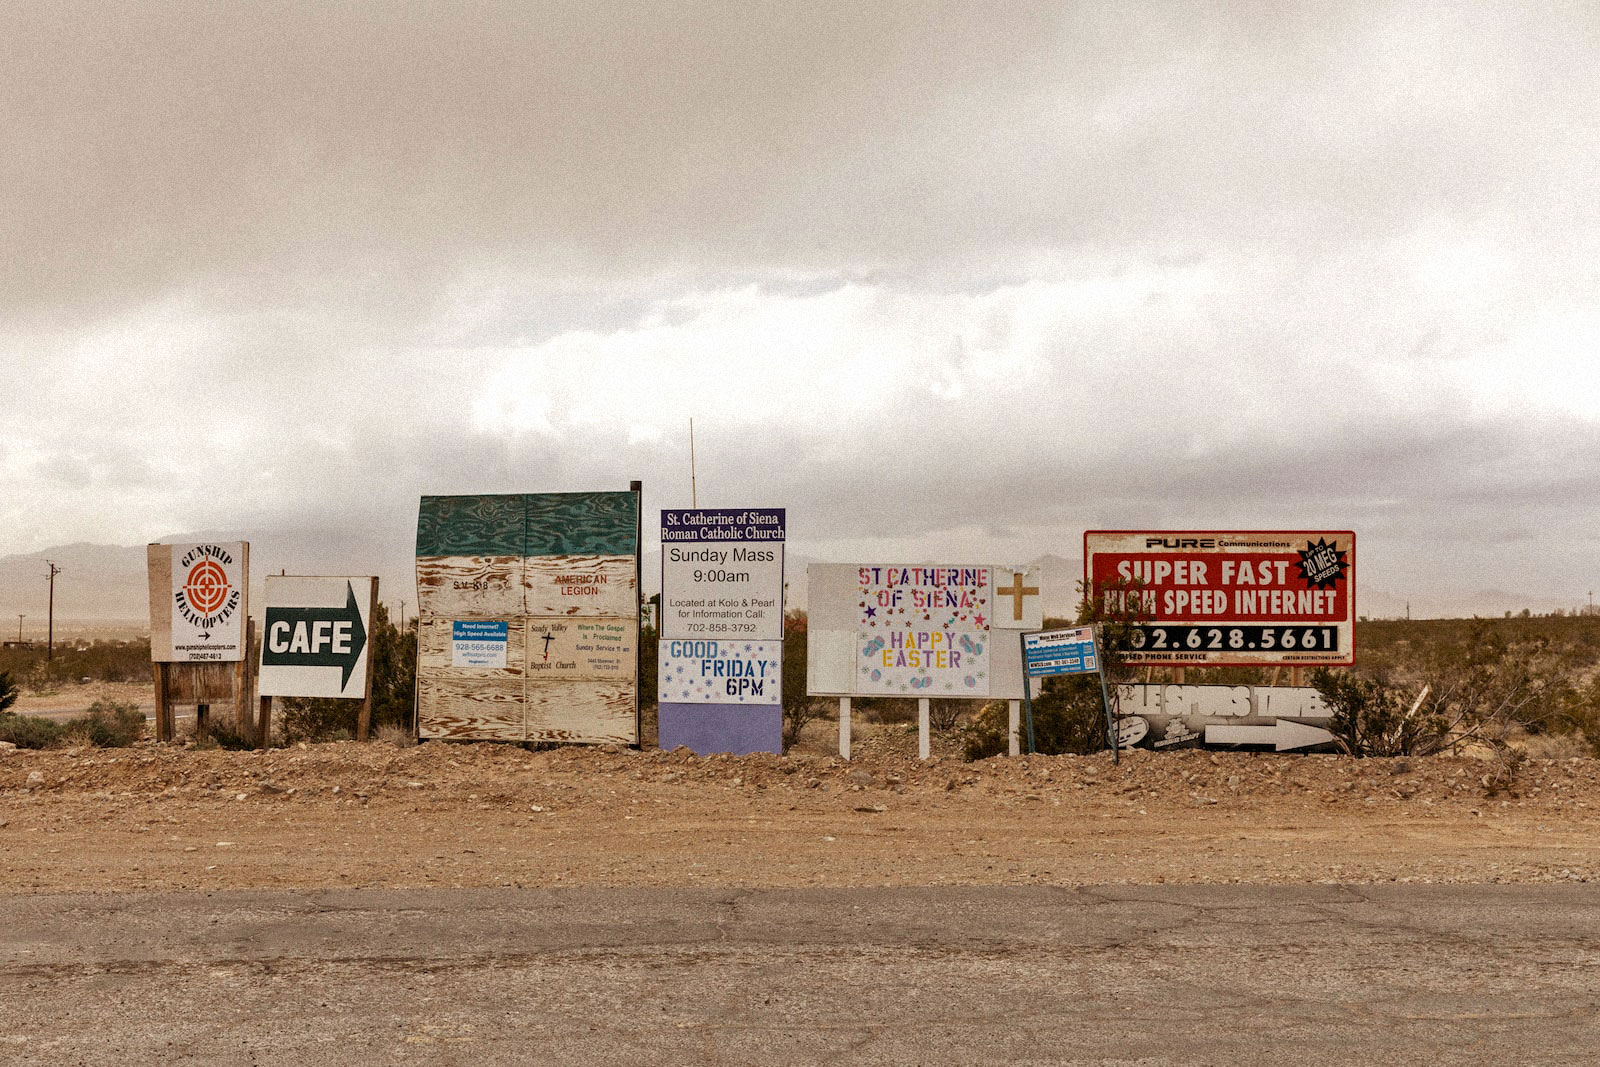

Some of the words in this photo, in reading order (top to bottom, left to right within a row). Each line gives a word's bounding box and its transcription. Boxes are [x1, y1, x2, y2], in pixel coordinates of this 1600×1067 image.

[667, 512, 681, 526] St.
[682, 512, 734, 525] Catherine
[736, 512, 748, 525] of
[749, 511, 779, 525] Siena
[661, 527, 698, 540] Roman
[699, 526, 744, 540] Catholic
[745, 526, 785, 539] Church
[1146, 538, 1216, 549] PURE
[1218, 540, 1291, 548] Communications
[1314, 544, 1325, 553] TO
[182, 544, 233, 568] GUNSHIP
[670, 547, 728, 566] Sunday
[733, 548, 774, 562] Mass
[1303, 558, 1317, 578] 20
[1313, 547, 1338, 572] MEG
[555, 575, 607, 585] AMERICAN
[693, 569, 750, 583] 9:00am
[859, 568, 881, 586] ST
[887, 568, 988, 586] CATHERINE
[1117, 560, 1208, 586] SUPER
[1221, 560, 1290, 586] FAST
[1313, 563, 1341, 583] SPEEDS
[561, 587, 598, 596] LEGION
[877, 589, 903, 608] OF
[912, 589, 971, 608] SIENA
[175, 590, 241, 630] HELICOPTERS
[669, 599, 705, 607] Located
[741, 599, 748, 607] &
[751, 599, 775, 608] Pearl
[1104, 589, 1157, 614] HIGH
[1164, 589, 1228, 615] SPEED
[1234, 589, 1337, 615] INTERNET
[678, 610, 690, 618] for
[692, 610, 742, 618] Information
[745, 609, 766, 619] Call:
[531, 624, 548, 633] Sandy
[551, 624, 568, 633] Valley
[606, 624, 625, 632] Gospel
[686, 623, 757, 632] 702-858-3792
[268, 621, 353, 654] CAFE
[891, 631, 955, 650] HAPPY
[1110, 628, 1331, 649] 02.628.5661
[175, 643, 237, 652] www.gunshiphelicopters.com
[576, 644, 594, 652] Sunday
[595, 645, 615, 653] Service
[671, 641, 718, 659] GOOD
[882, 649, 961, 669] EASTER
[1145, 653, 1173, 661] PHONE
[1175, 653, 1207, 661] SERVICE
[530, 661, 552, 671] Baptist
[555, 661, 577, 670] Church
[701, 659, 768, 678] FRIDAY
[726, 678, 764, 697] 6PM
